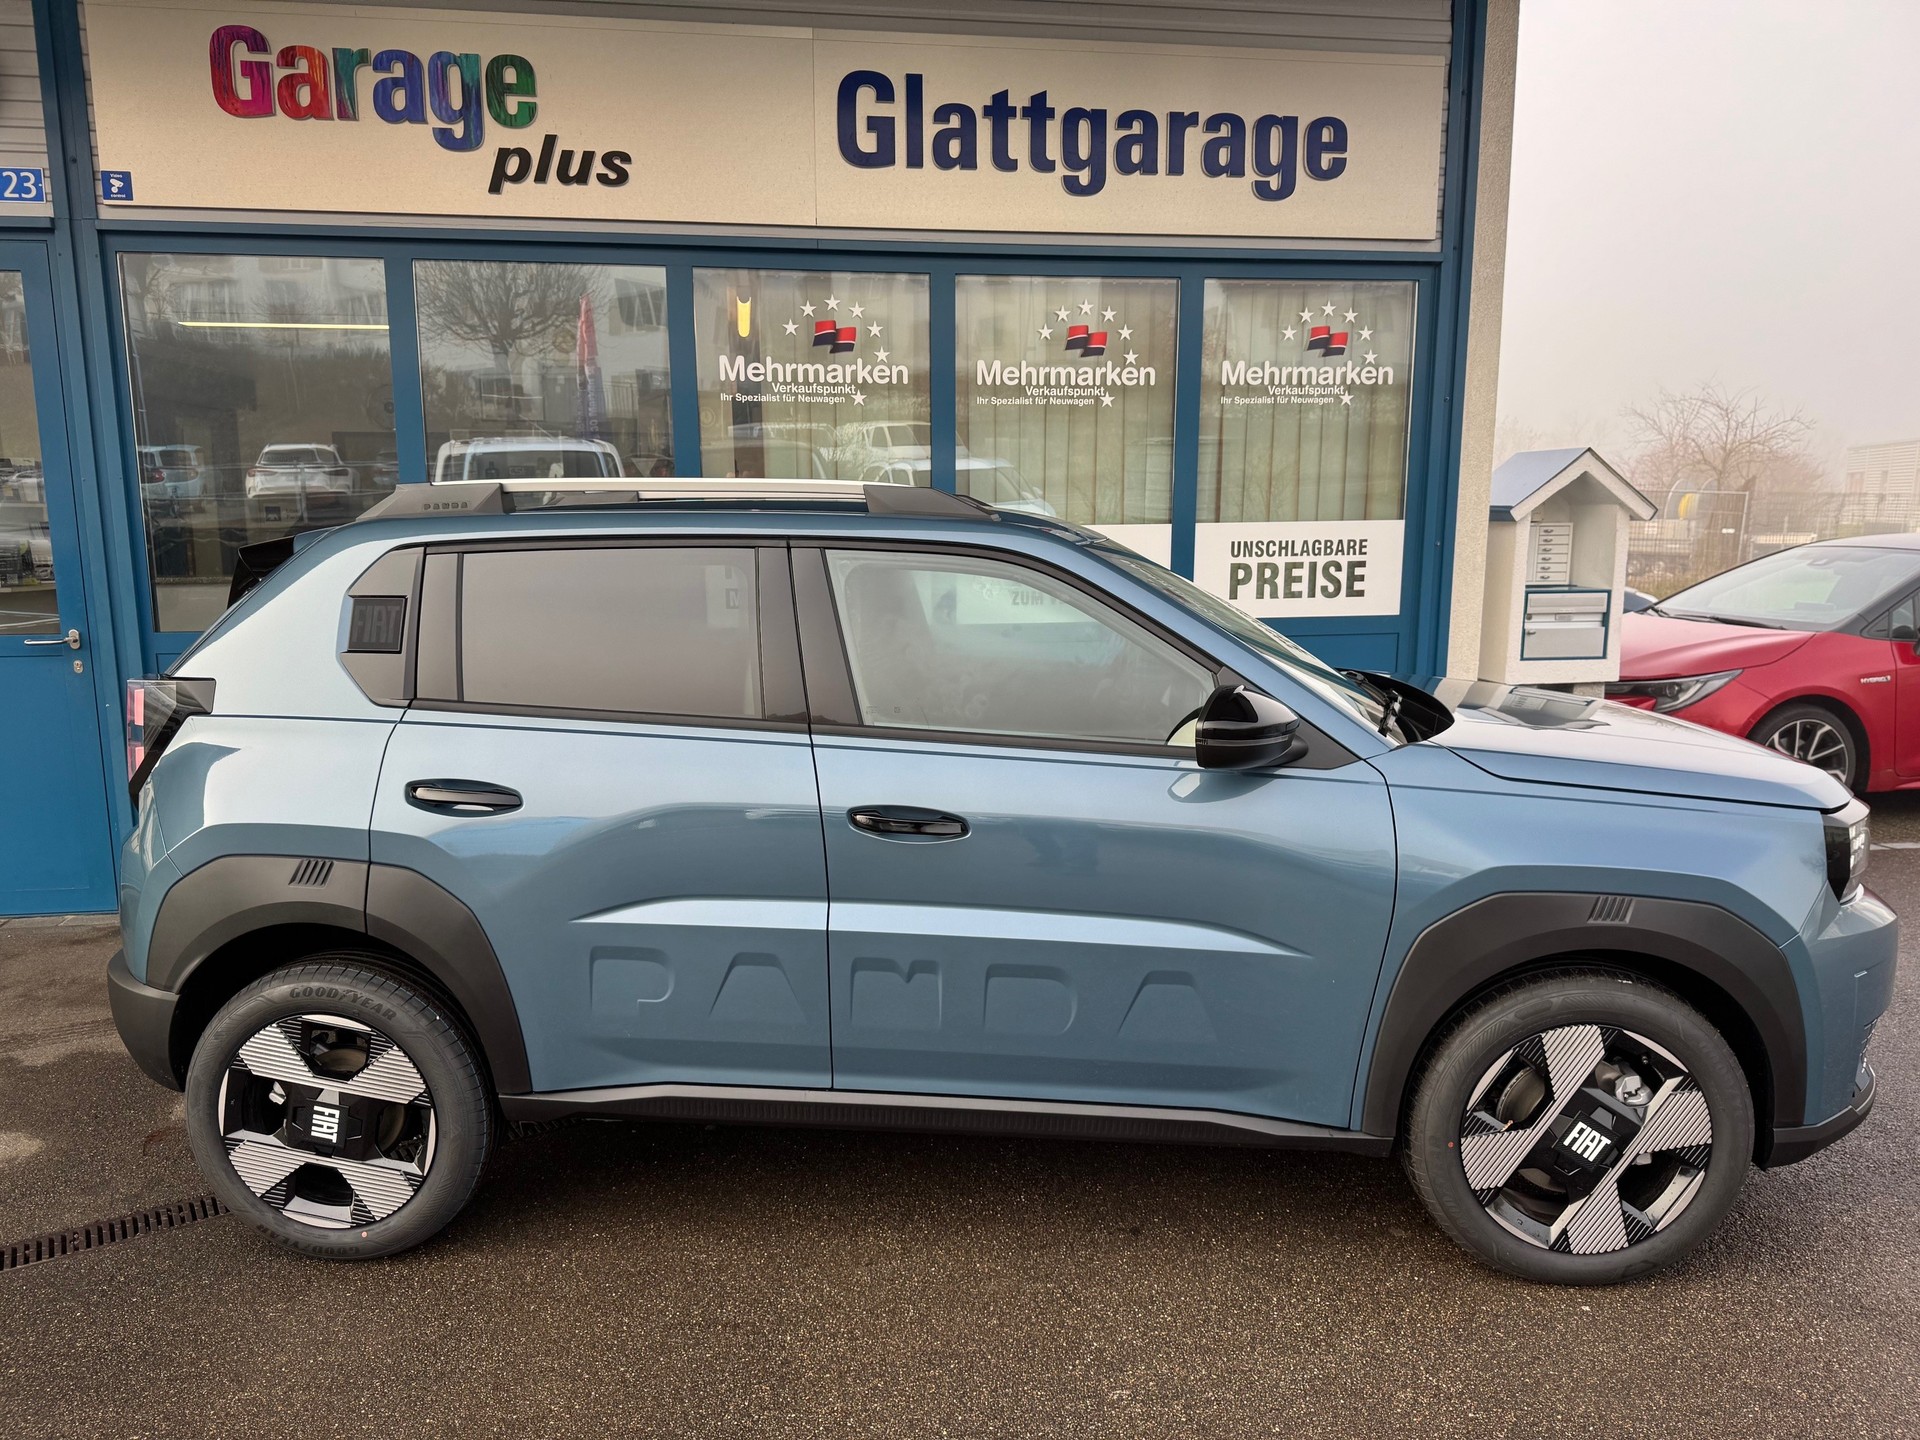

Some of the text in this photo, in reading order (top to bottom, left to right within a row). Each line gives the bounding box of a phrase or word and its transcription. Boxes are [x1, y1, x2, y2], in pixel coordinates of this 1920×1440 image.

[208, 24, 538, 152] Garage
[837, 69, 1348, 201] Glattgarage
[488, 134, 632, 195] plus
[1, 171, 38, 199] 23
[718, 354, 909, 385] Mehrmarken
[976, 359, 1156, 387] Mehrmarken
[1220, 360, 1394, 386] Mehrmarken
[720, 393, 846, 405] Ihr Spezialist für Neuwagen
[772, 382, 856, 396] Verkaufspunkt
[976, 396, 1095, 407] Ihr Spezialist für Neuwagen
[1025, 385, 1105, 398] Verkaufspunkt
[1220, 395, 1334, 406] Ihr Spezialist für Neuwagen
[1268, 384, 1345, 397] Verkaufspunkt
[423, 501, 468, 511] PANDA
[1230, 539, 1368, 558] UNSCHLAGBARE
[1228, 560, 1367, 601] PREISE
[352, 604, 400, 644] FIAT
[588, 944, 1220, 1043] PANDA
[310, 1105, 341, 1144] FIAT
[1562, 1121, 1612, 1162] FIAT
